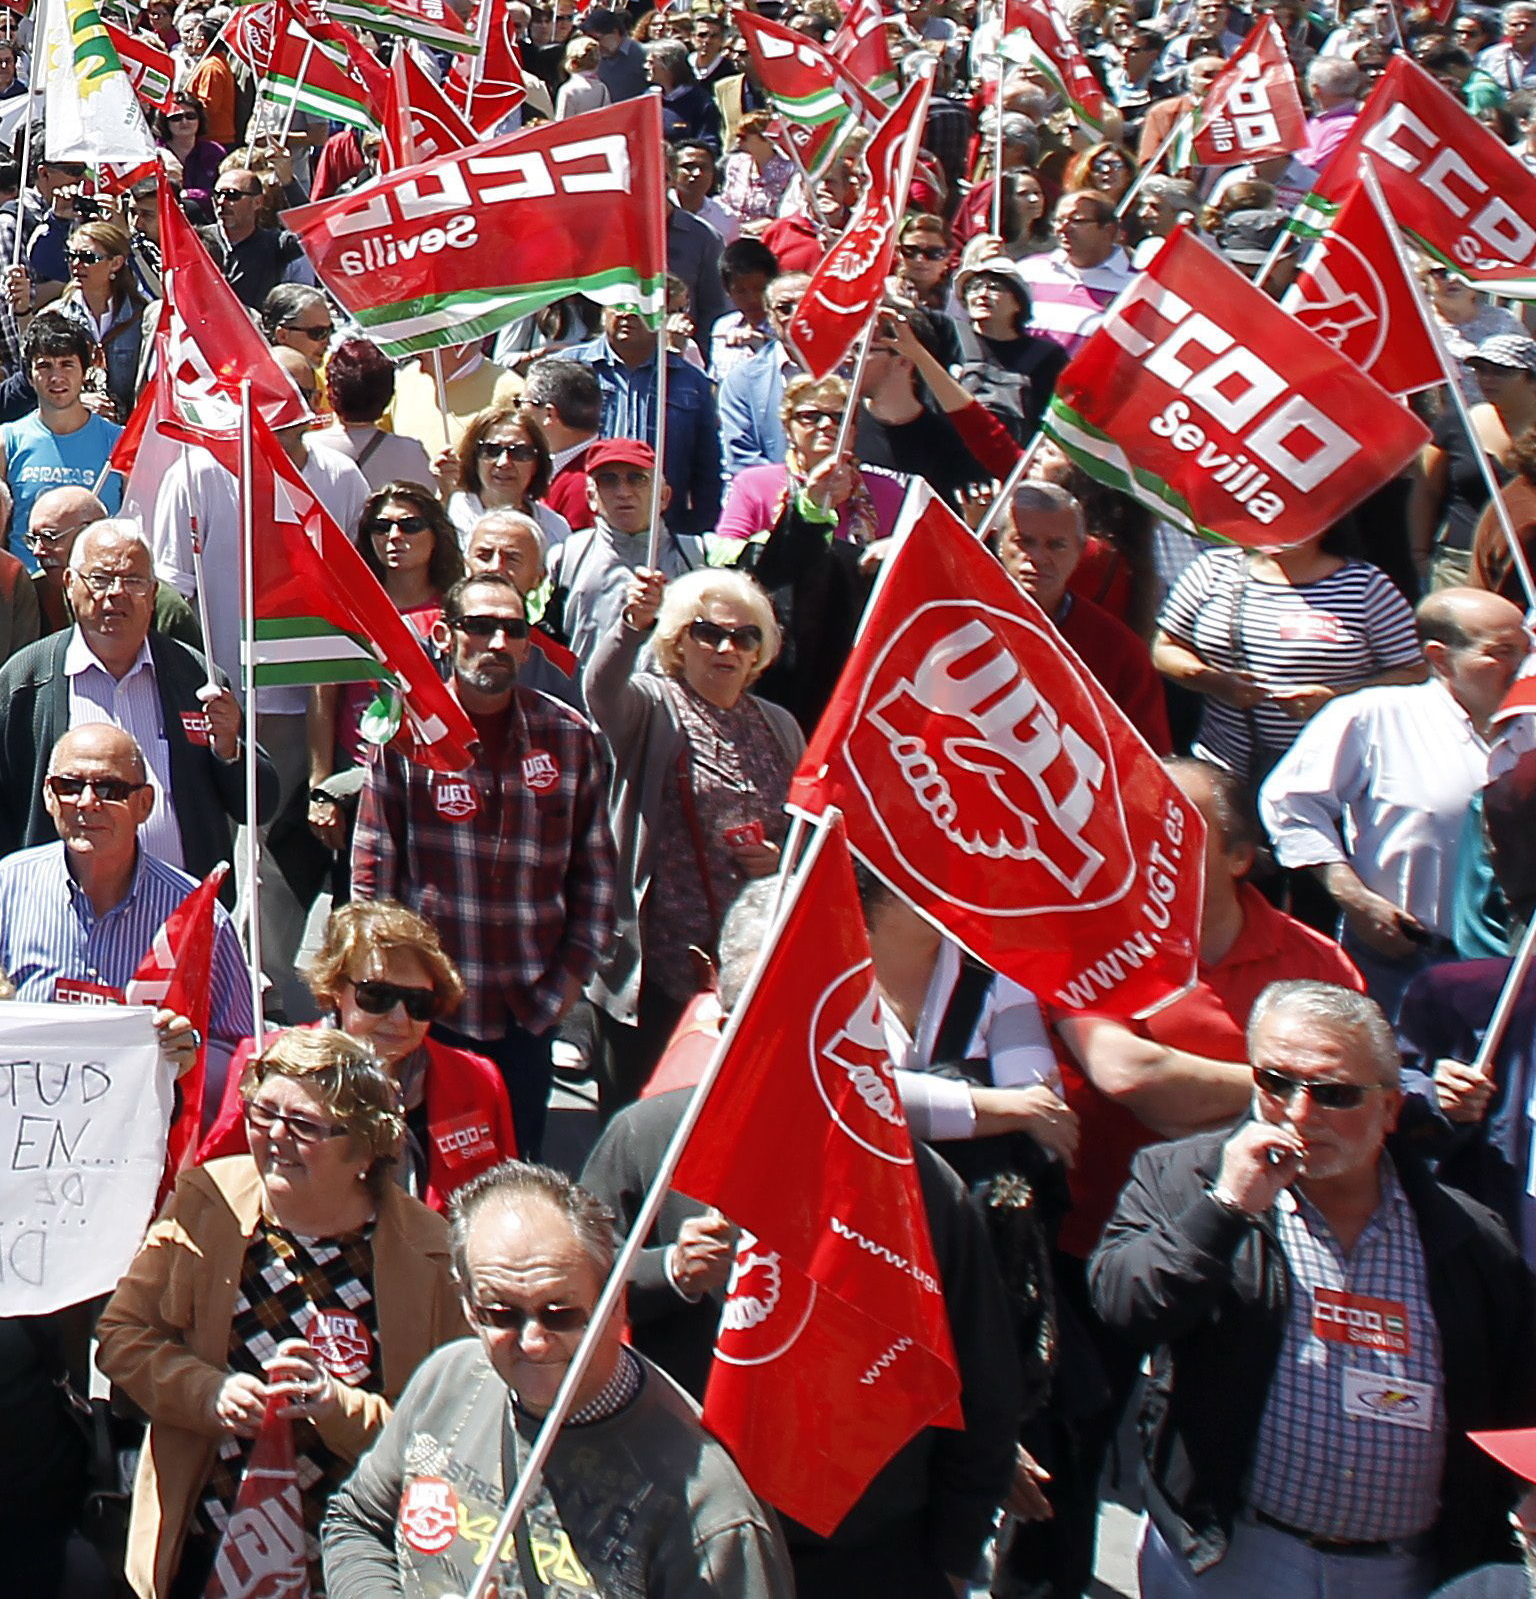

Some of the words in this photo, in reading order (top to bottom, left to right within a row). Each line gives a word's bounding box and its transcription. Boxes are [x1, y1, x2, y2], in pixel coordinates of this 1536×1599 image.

[1102, 271, 1363, 492] CCOO
[1150, 401, 1286, 524] Sevilla
[915, 620, 1105, 834] UGT
[523, 753, 552, 779] UGT
[438, 785, 472, 805] UGT
[1055, 800, 1187, 1010] www.UGT.es
[437, 1127, 480, 1154] CCOO
[1314, 1300, 1382, 1332] CCOO
[1349, 1327, 1404, 1350] Sevilla
[407, 1483, 449, 1507] UGT
